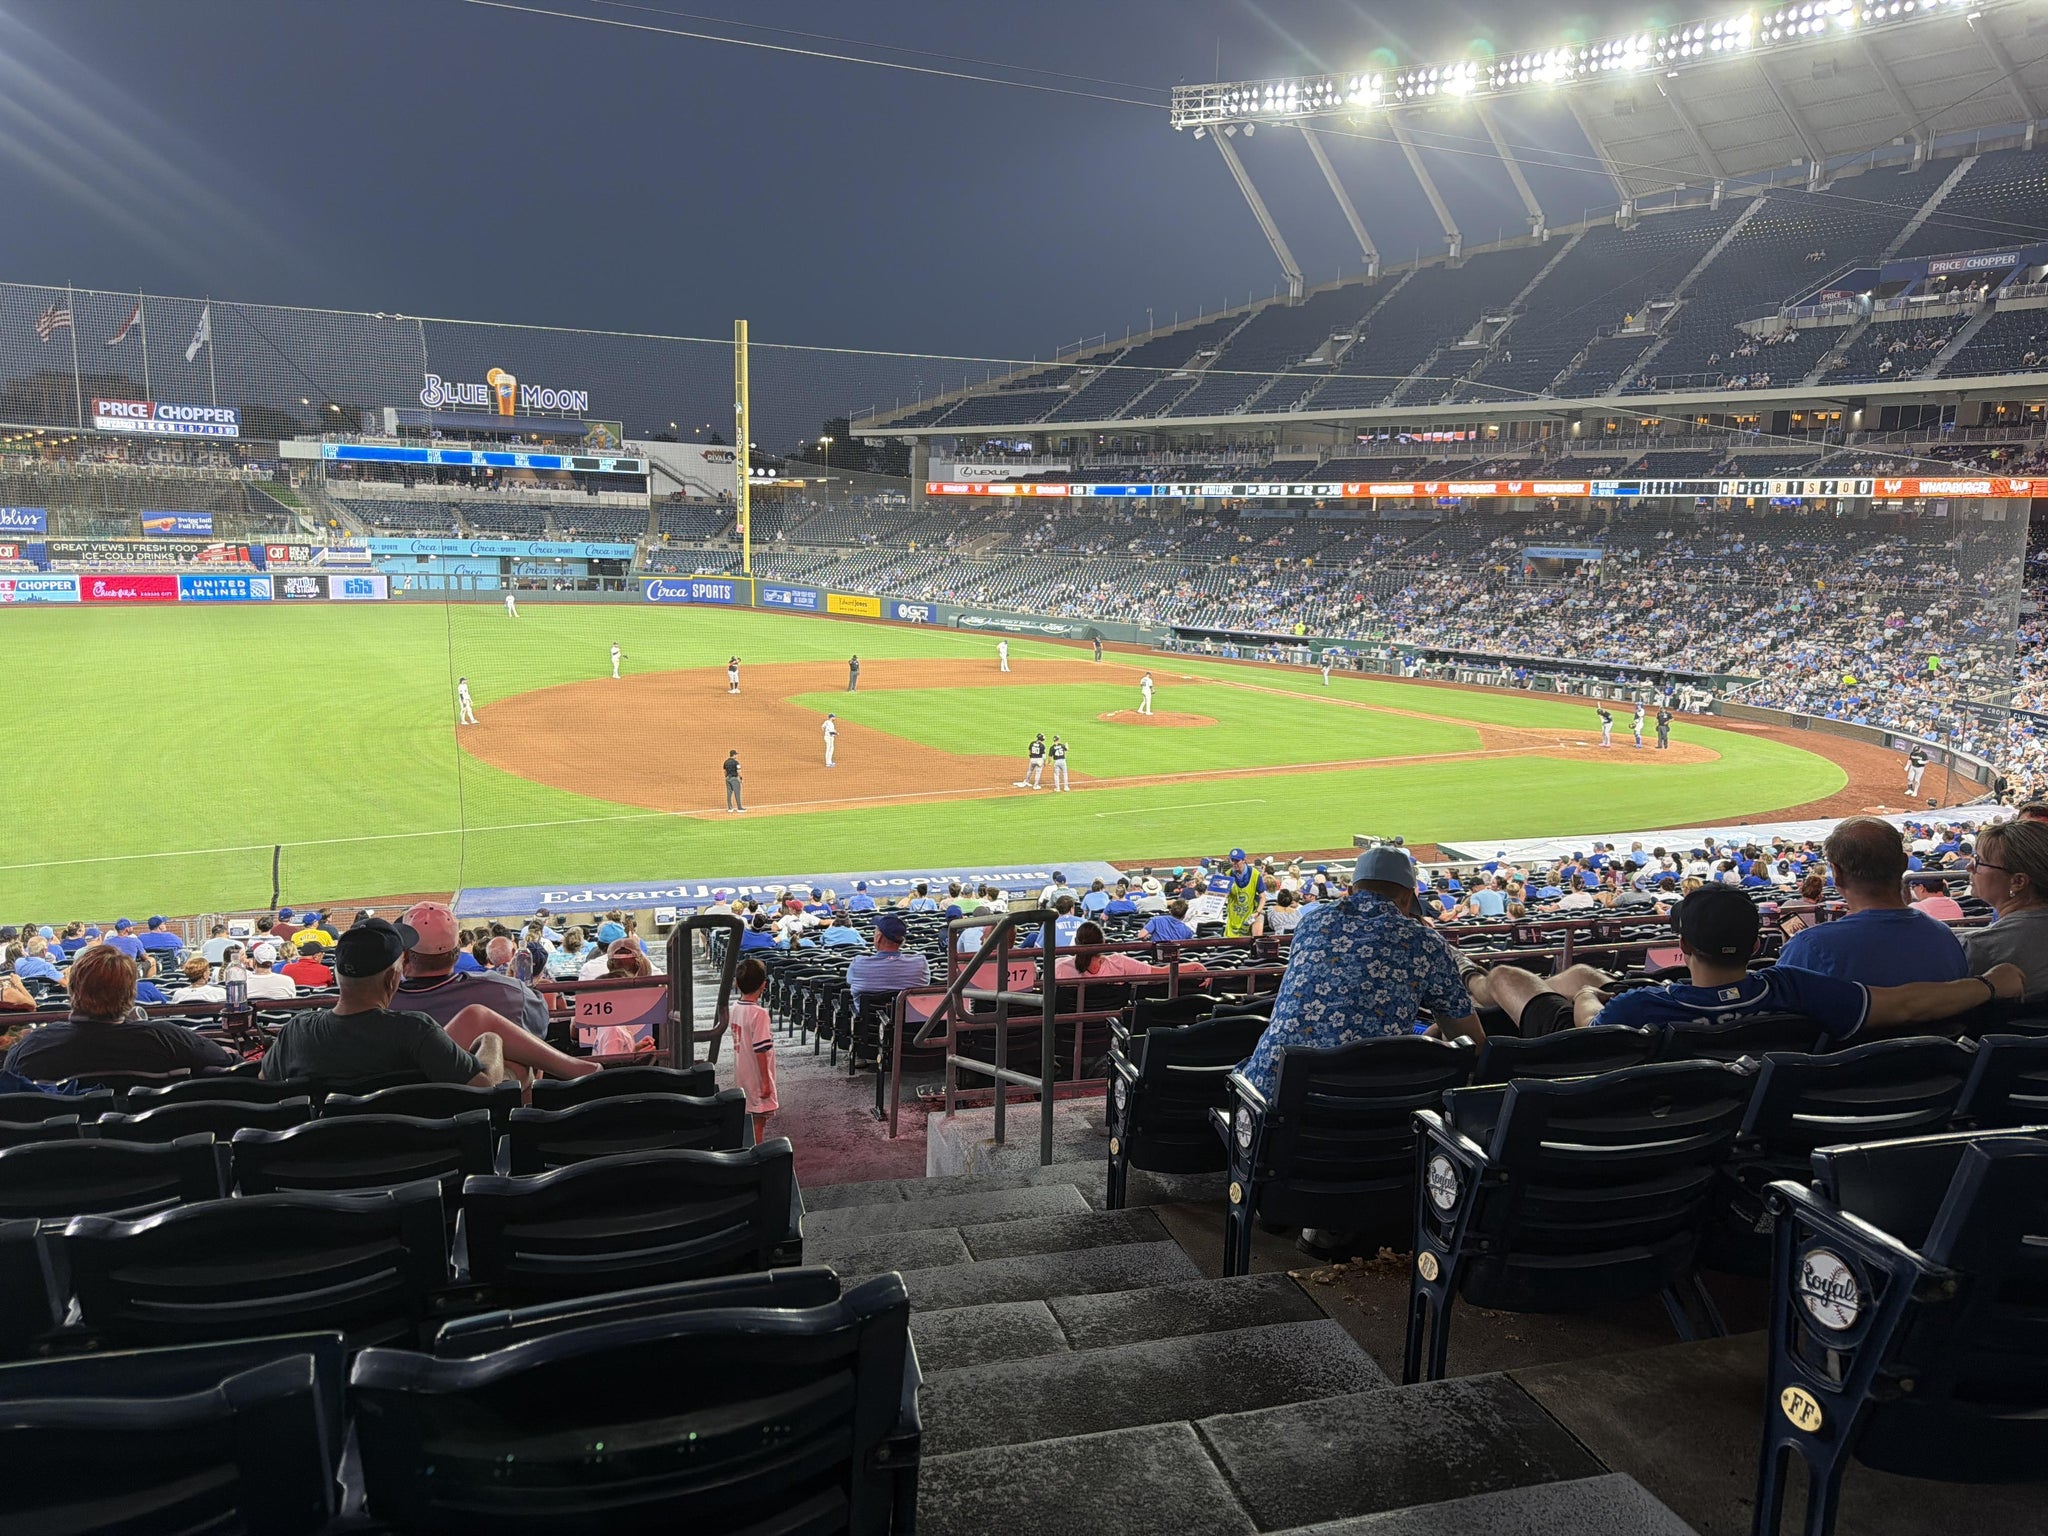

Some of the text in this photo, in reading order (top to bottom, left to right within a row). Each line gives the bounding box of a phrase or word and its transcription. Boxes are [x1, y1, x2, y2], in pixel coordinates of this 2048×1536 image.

[1932, 255, 2016, 271] PRICE CHOPPER
[420, 373, 588, 411] BLUE MOON
[98, 402, 236, 423] PRICE CHOPPER
[973, 468, 1010, 476] LEXUS
[1775, 483, 1781, 493] B
[1792, 482, 1797, 494] 1
[1808, 483, 1814, 492] S
[1825, 481, 1832, 494] 2
[1919, 481, 1991, 494] WHATABURGER
[0, 547, 14, 558] QT
[53, 543, 89, 551] GREAT
[91, 544, 125, 552] VIEWS
[133, 544, 167, 552] FRESH
[270, 547, 285, 559] QT
[410, 540, 437, 553] Circa
[470, 541, 496, 554] Circa
[528, 542, 554, 555] Circa
[585, 544, 611, 557] Circa
[517, 561, 548, 575] Circa
[18, 581, 72, 591] CHOPPER
[193, 580, 246, 588] UNITED
[647, 580, 731, 601] Circa SPORTS
[181, 588, 247, 597] AIRLINES
[539, 871, 1050, 903] Edward Jones DUGOUT SUITES
[583, 1002, 613, 1016] 216
[1800, 1261, 1858, 1307] Royals
[1788, 1391, 1815, 1424] FF
